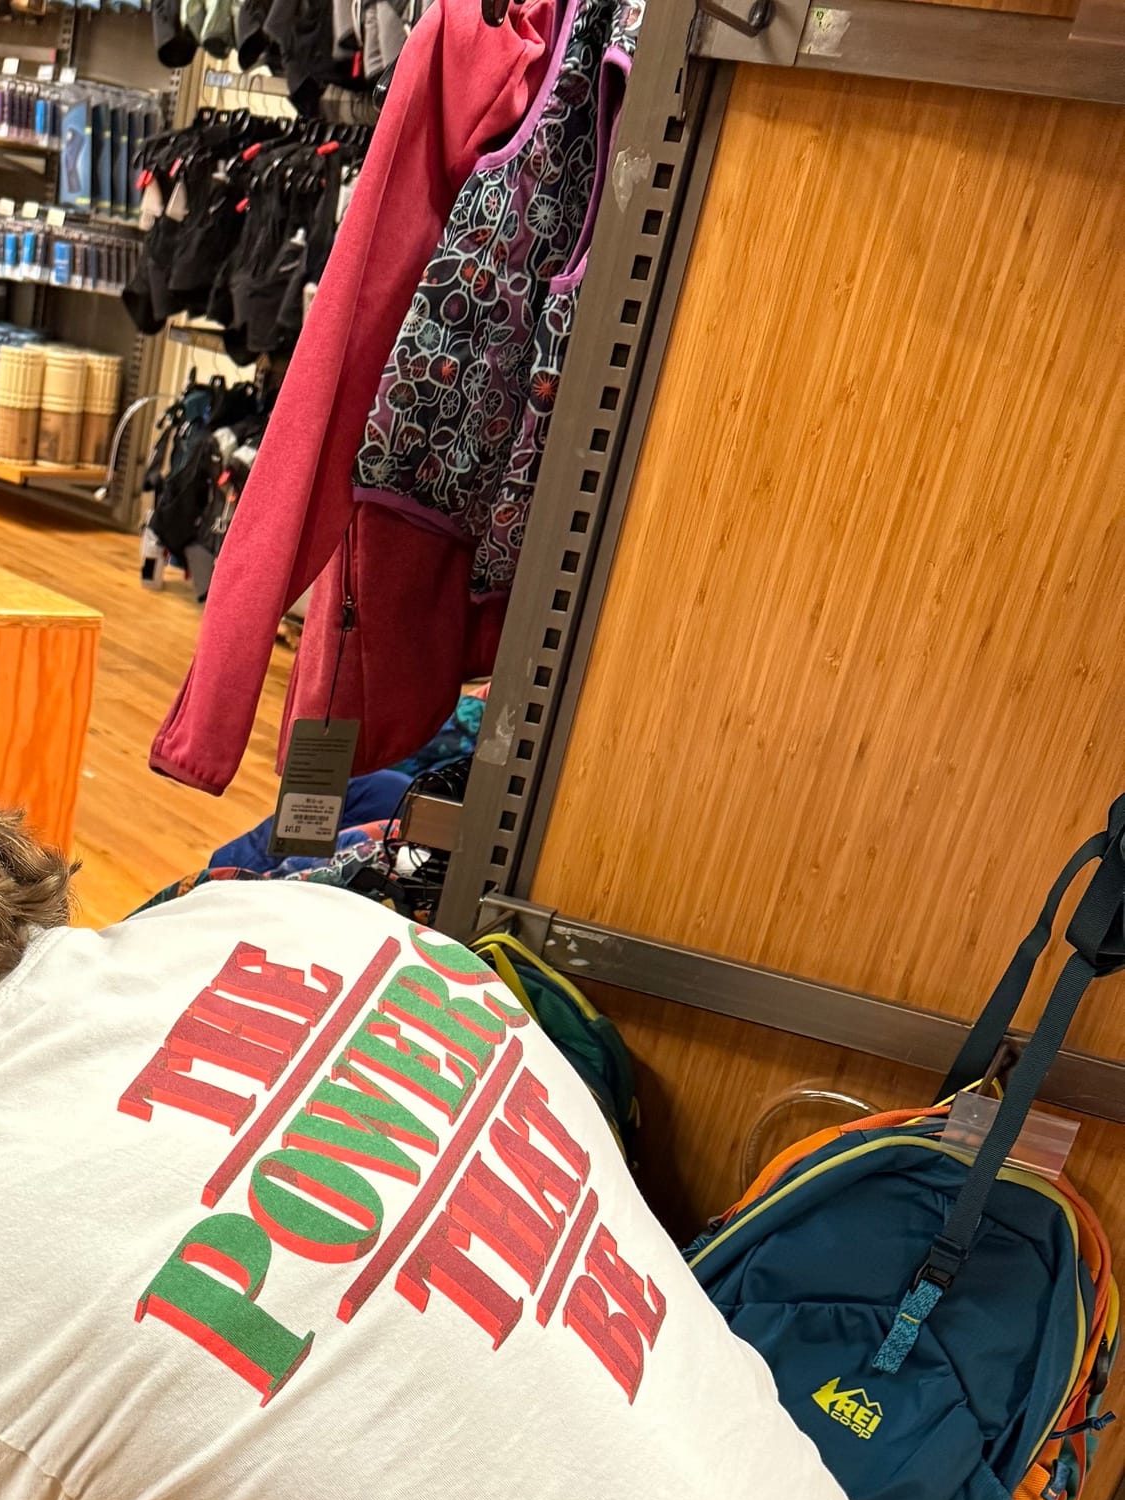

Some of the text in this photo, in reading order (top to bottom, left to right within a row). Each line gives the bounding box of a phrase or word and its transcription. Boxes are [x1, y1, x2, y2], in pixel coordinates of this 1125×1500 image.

[117, 941, 343, 1136] THE
[395, 1067, 591, 1350] THAT
[563, 1222, 666, 1405] BE
[834, 1398, 882, 1433] REI
